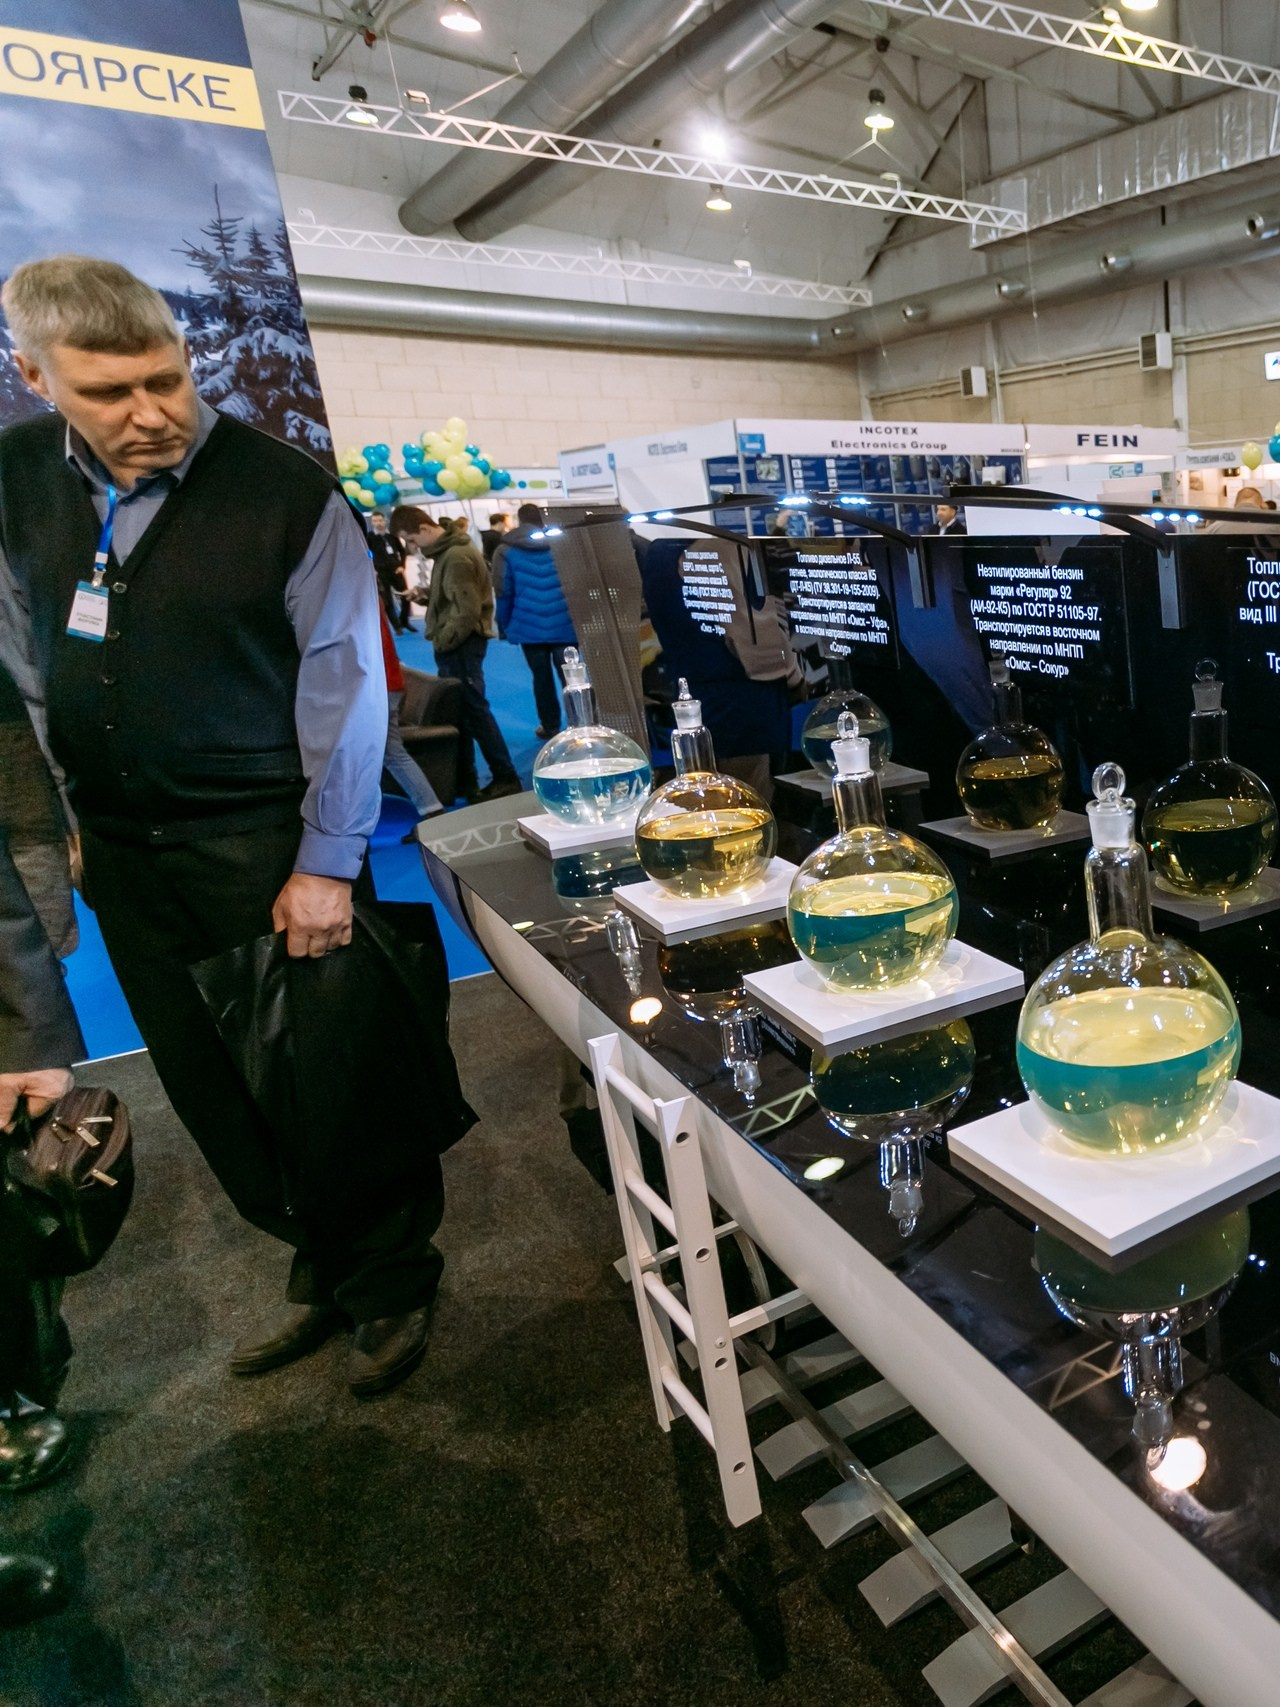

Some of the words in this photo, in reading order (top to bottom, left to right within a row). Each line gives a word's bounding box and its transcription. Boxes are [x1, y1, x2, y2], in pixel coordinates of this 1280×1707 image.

[2, 42, 237, 112] ОЯРСКЕ
[859, 426, 919, 436] INCOTEX
[830, 439, 907, 450] Electronics
[911, 440, 948, 452] Group
[1077, 433, 1139, 448] FEIN
[977, 564, 1050, 581] Неэтилированный
[1052, 565, 1083, 580] бензин
[990, 585, 1014, 599] марки
[1016, 584, 1058, 601] «Регуляр»
[1060, 585, 1072, 599] 92
[1012, 604, 1022, 615] по
[1057, 605, 1102, 621] 51105-97.
[1239, 606, 1262, 624] вид
[1053, 627, 1100, 641] восточном
[990, 639, 1041, 653] направлении
[1043, 645, 1053, 656] по
[1055, 643, 1083, 659] МНПП
[1005, 656, 1031, 671] «Омск
[1039, 660, 1069, 678] Сокур»
